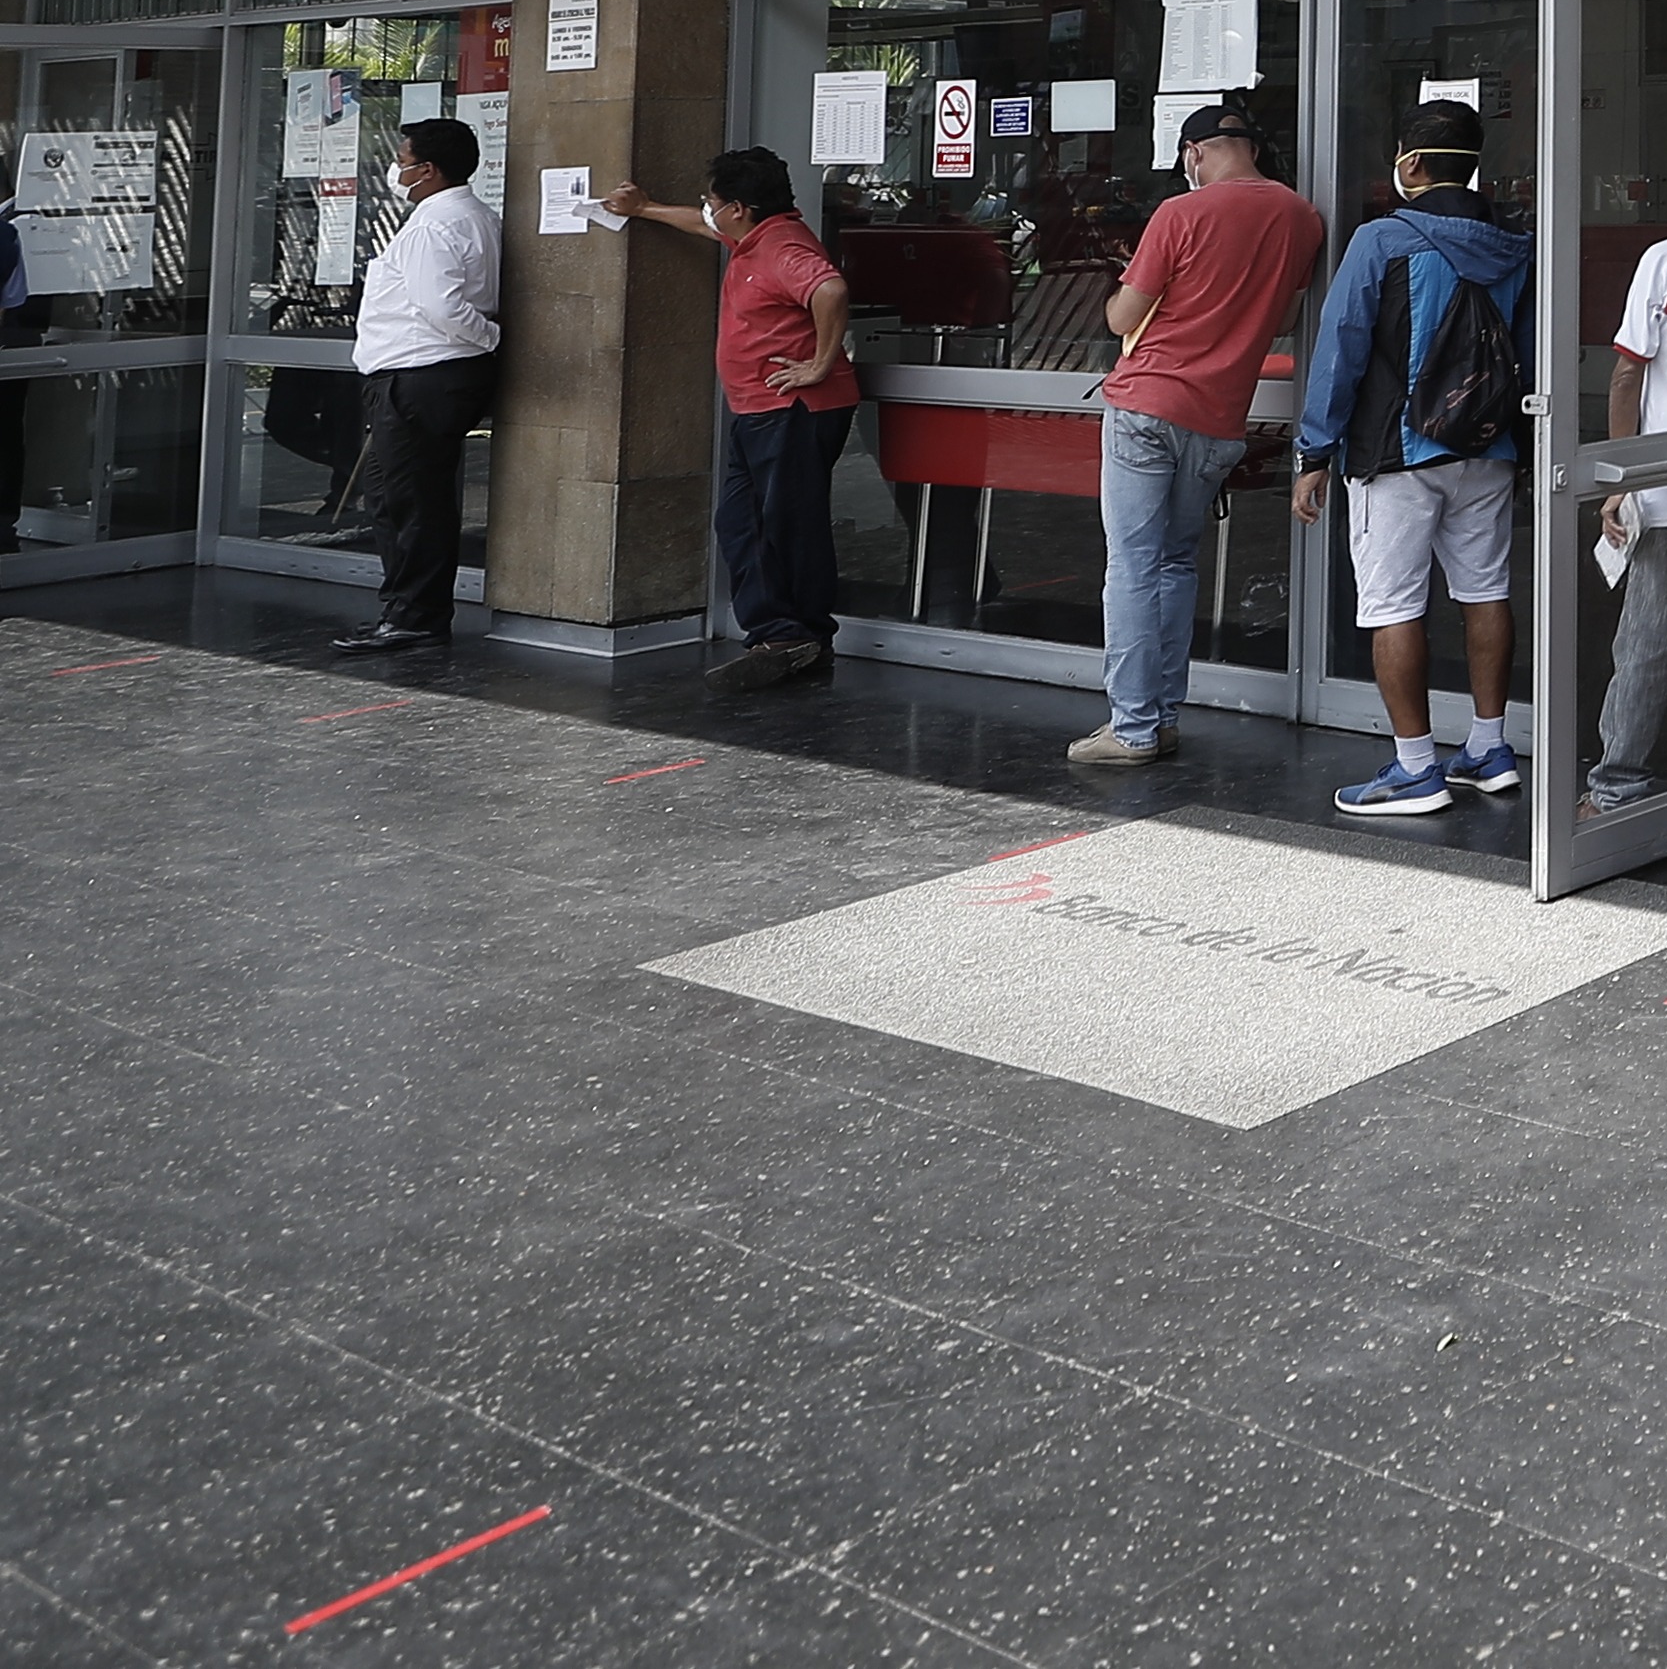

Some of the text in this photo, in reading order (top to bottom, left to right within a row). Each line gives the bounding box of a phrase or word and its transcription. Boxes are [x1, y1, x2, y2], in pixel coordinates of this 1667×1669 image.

[1032, 894, 1512, 1005] Banco de la Nación
